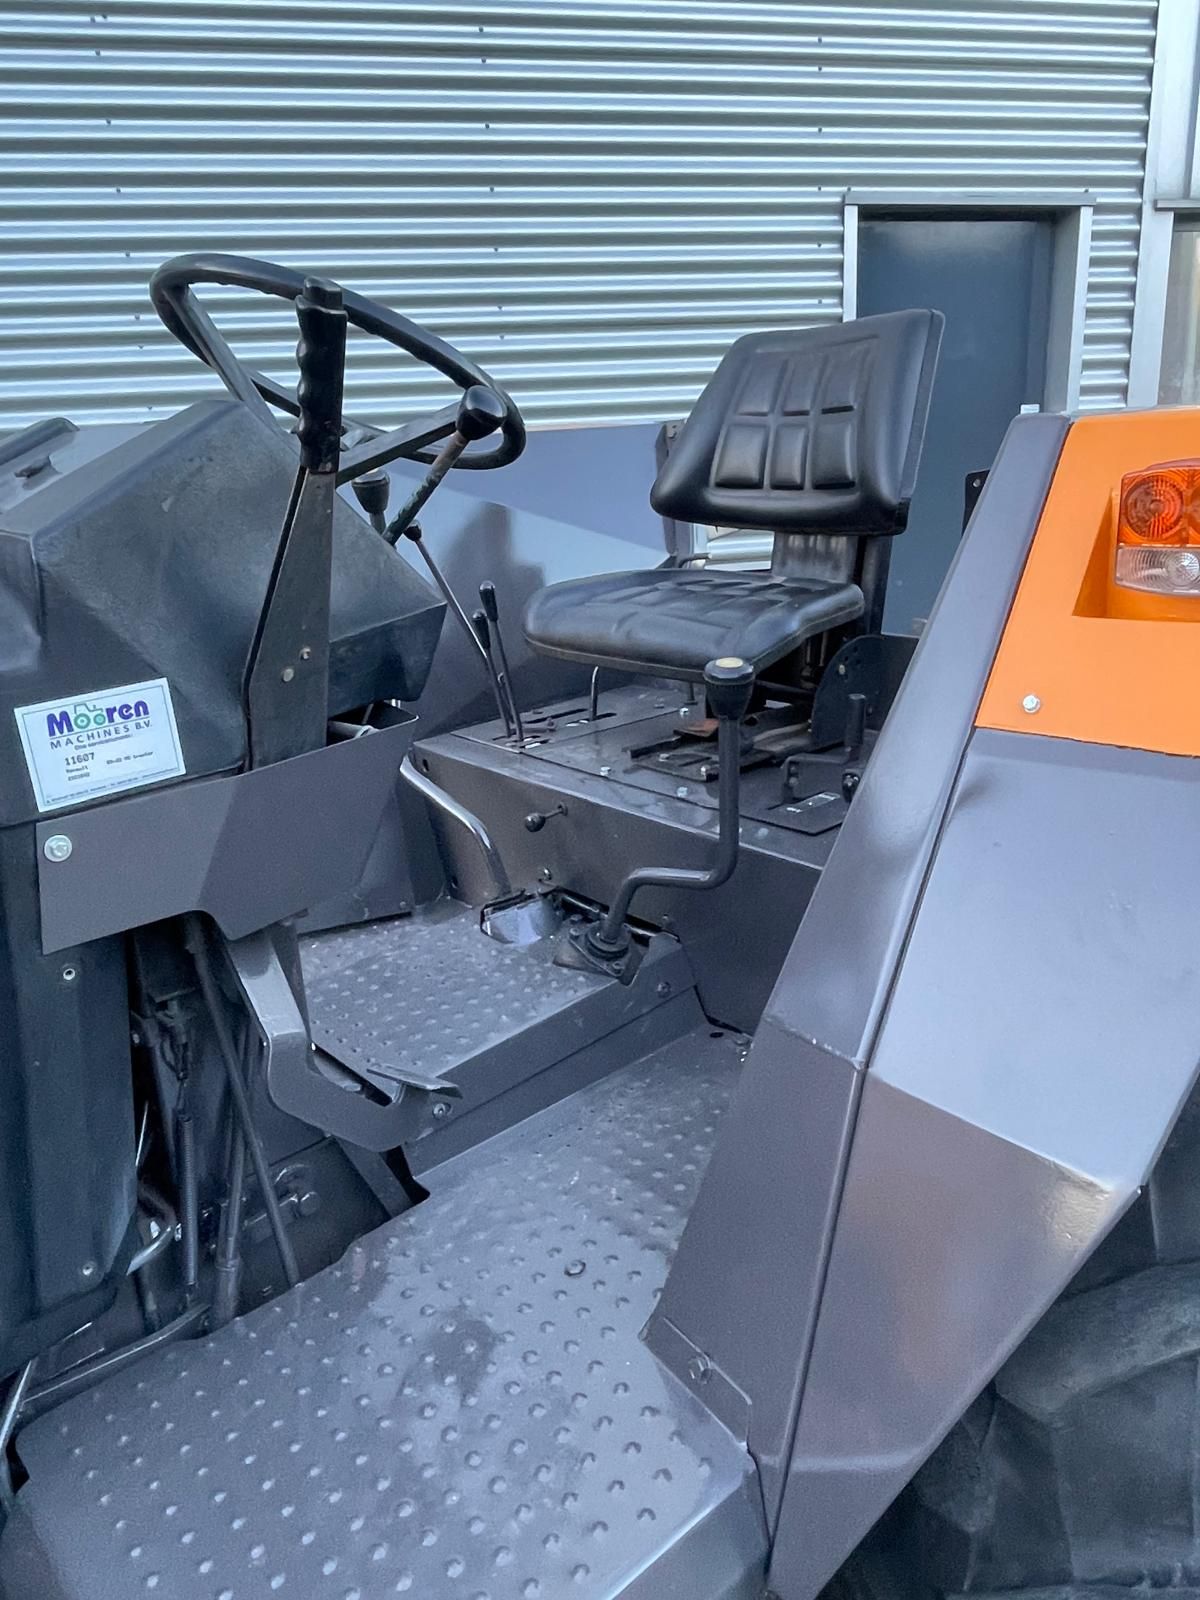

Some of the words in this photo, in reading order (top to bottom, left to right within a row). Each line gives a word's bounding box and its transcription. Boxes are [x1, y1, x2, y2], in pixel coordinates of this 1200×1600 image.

[47, 700, 150, 737] Mooren
[50, 723, 130, 750] MACHINES
[135, 719, 153, 731] B.V.
[64, 752, 95, 766] 11607
